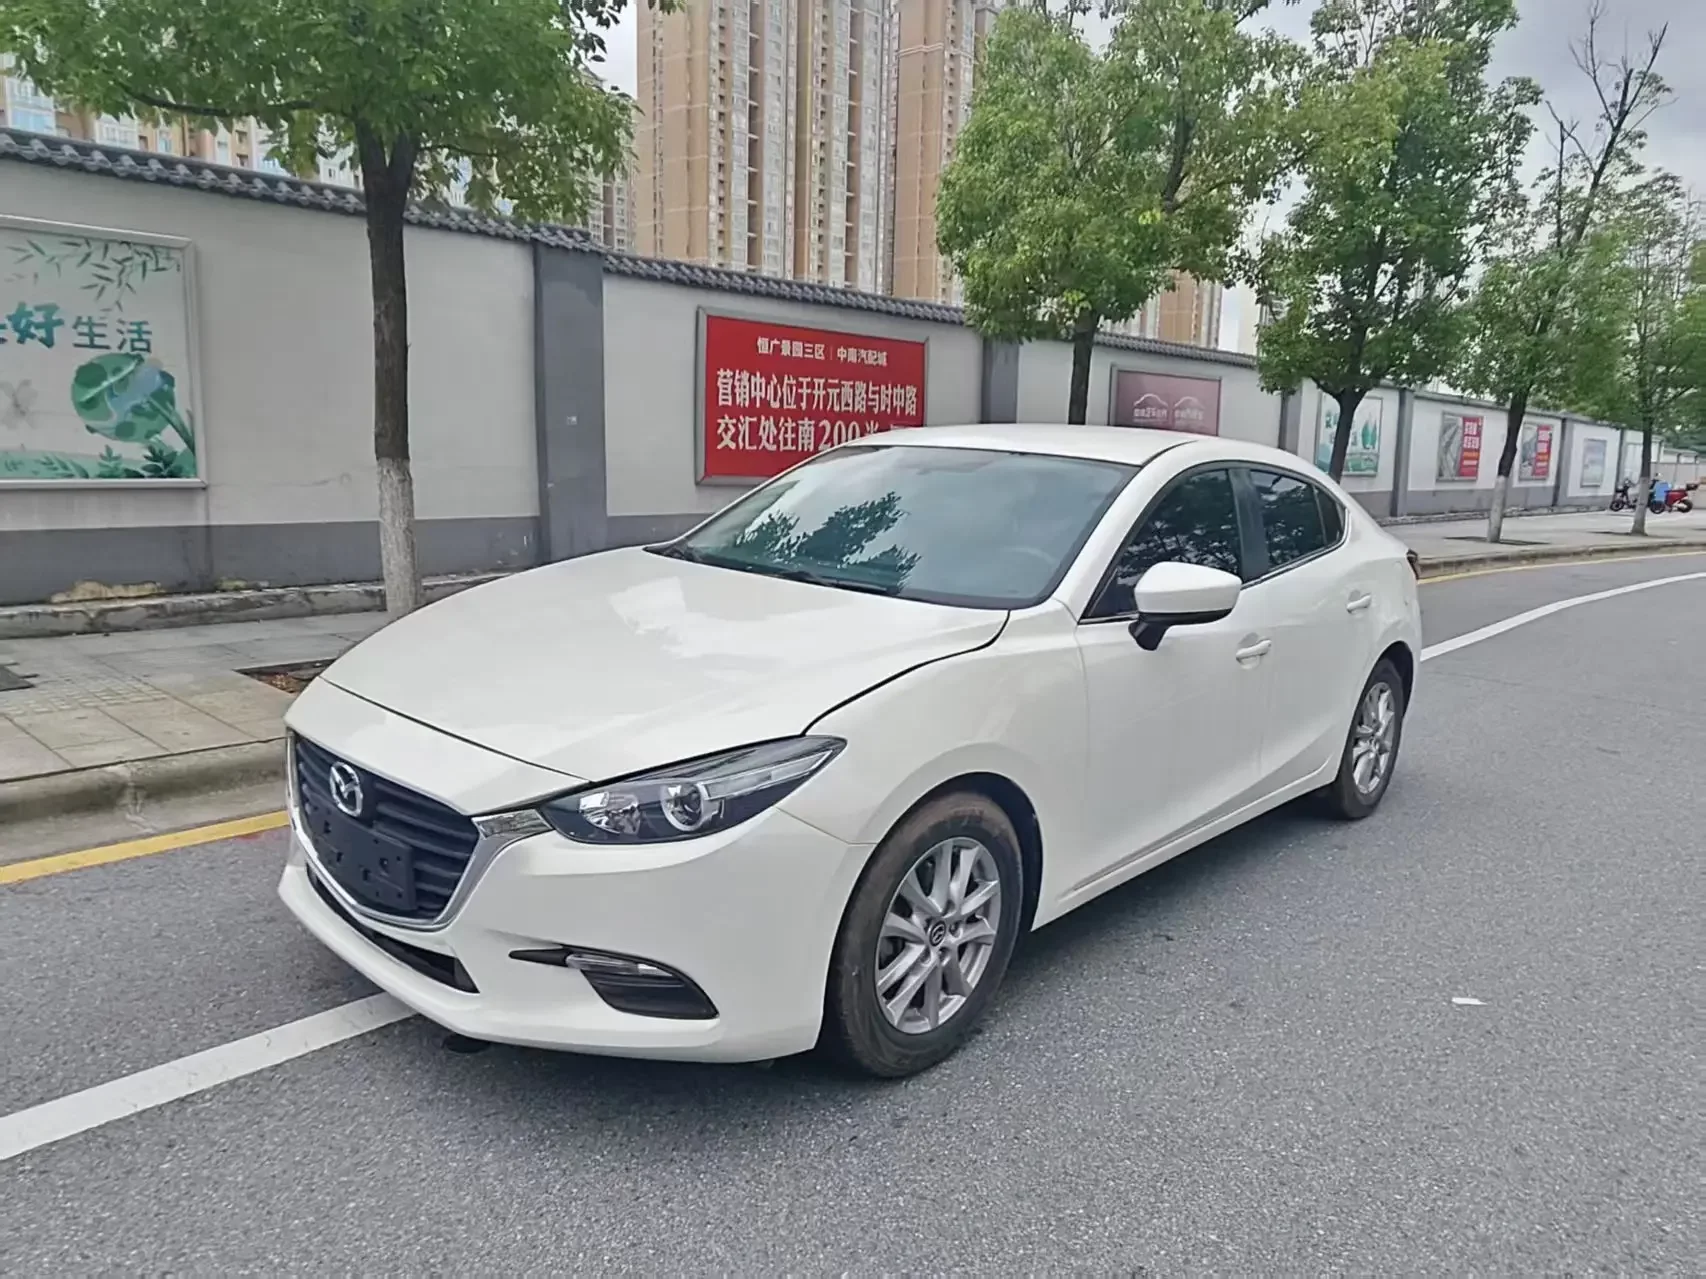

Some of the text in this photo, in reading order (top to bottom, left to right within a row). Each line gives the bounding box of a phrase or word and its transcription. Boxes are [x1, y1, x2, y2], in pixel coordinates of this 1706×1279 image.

[0, 301, 152, 353] 好生活
[717, 414, 906, 452] 交汇处往南200
